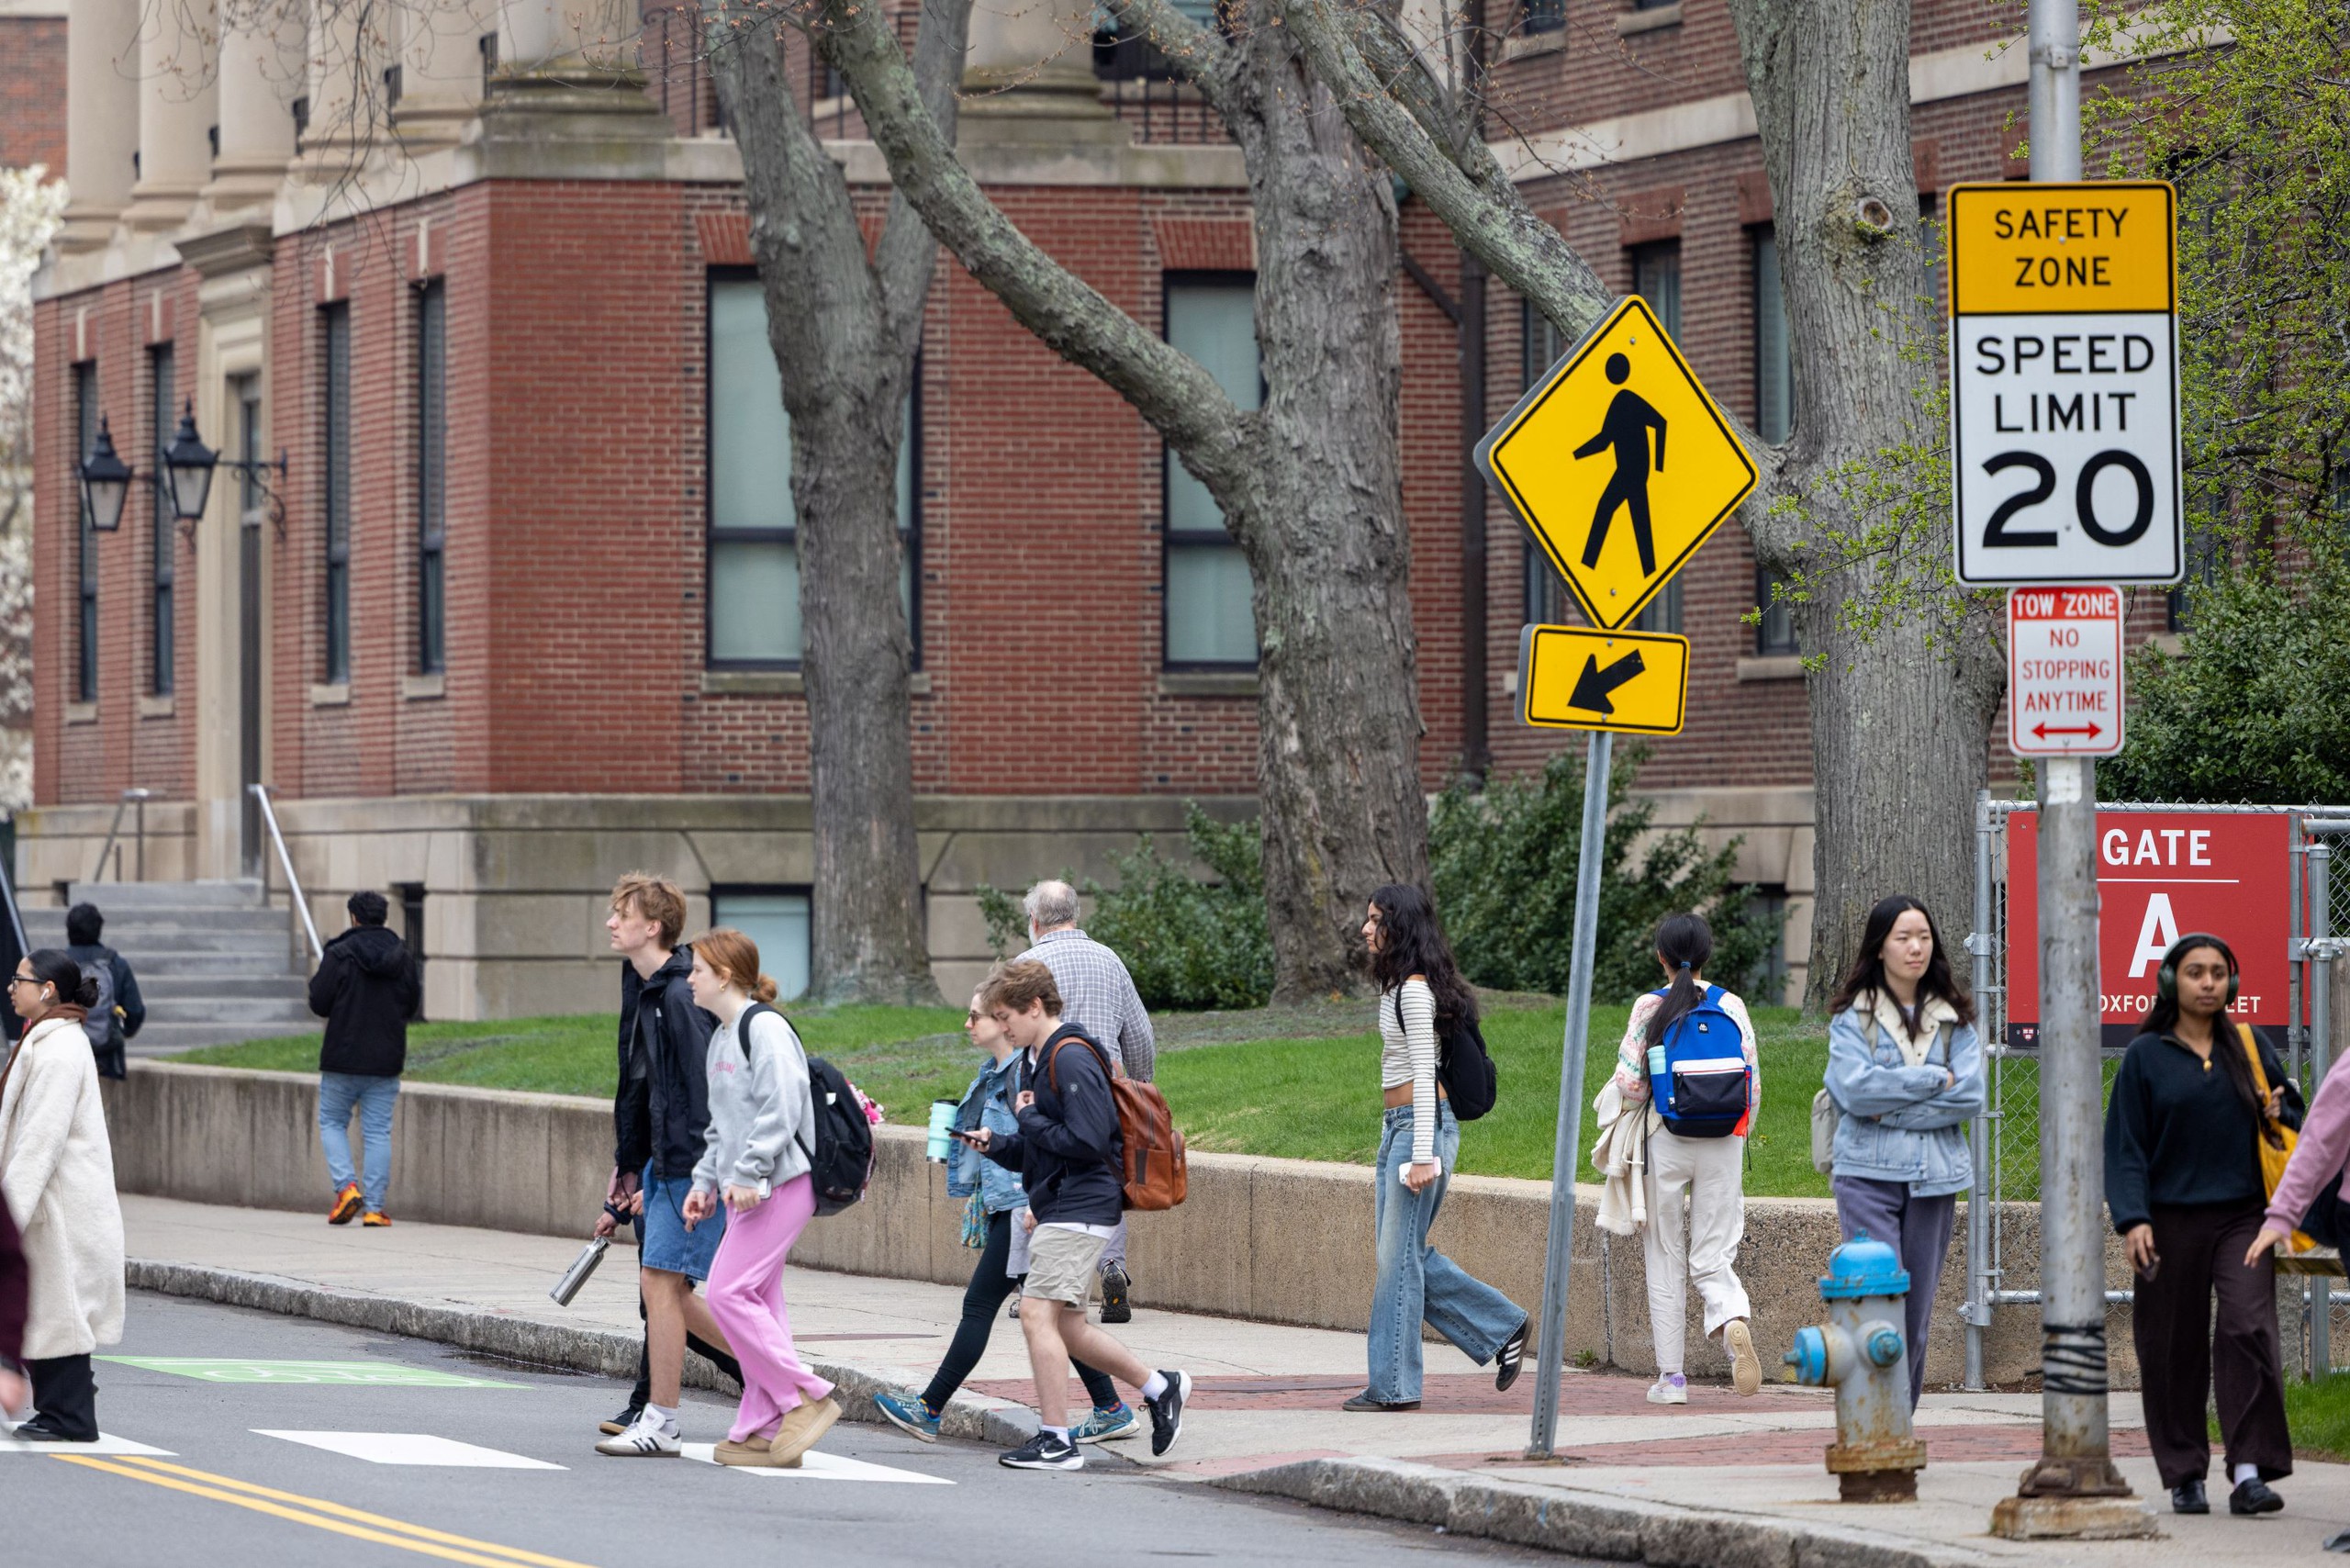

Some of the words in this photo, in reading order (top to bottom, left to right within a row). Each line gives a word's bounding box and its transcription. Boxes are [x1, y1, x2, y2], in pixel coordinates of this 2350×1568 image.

[1995, 207, 2128, 240] SAFETY
[2015, 257, 2110, 286] ZONE
[1976, 334, 2154, 375] SPEED
[1995, 392, 2136, 432] LIMIT
[1981, 449, 2154, 548] 20
[2014, 594, 2055, 617] TOW
[2065, 593, 2116, 617] ZONE
[2050, 629, 2079, 647] NO
[2022, 660, 2109, 680] STOPPING
[2025, 690, 2107, 712] ANYTIME
[2102, 828, 2211, 866] GATE
[2128, 893, 2181, 979] A
[2099, 994, 2158, 1013] OXFO
